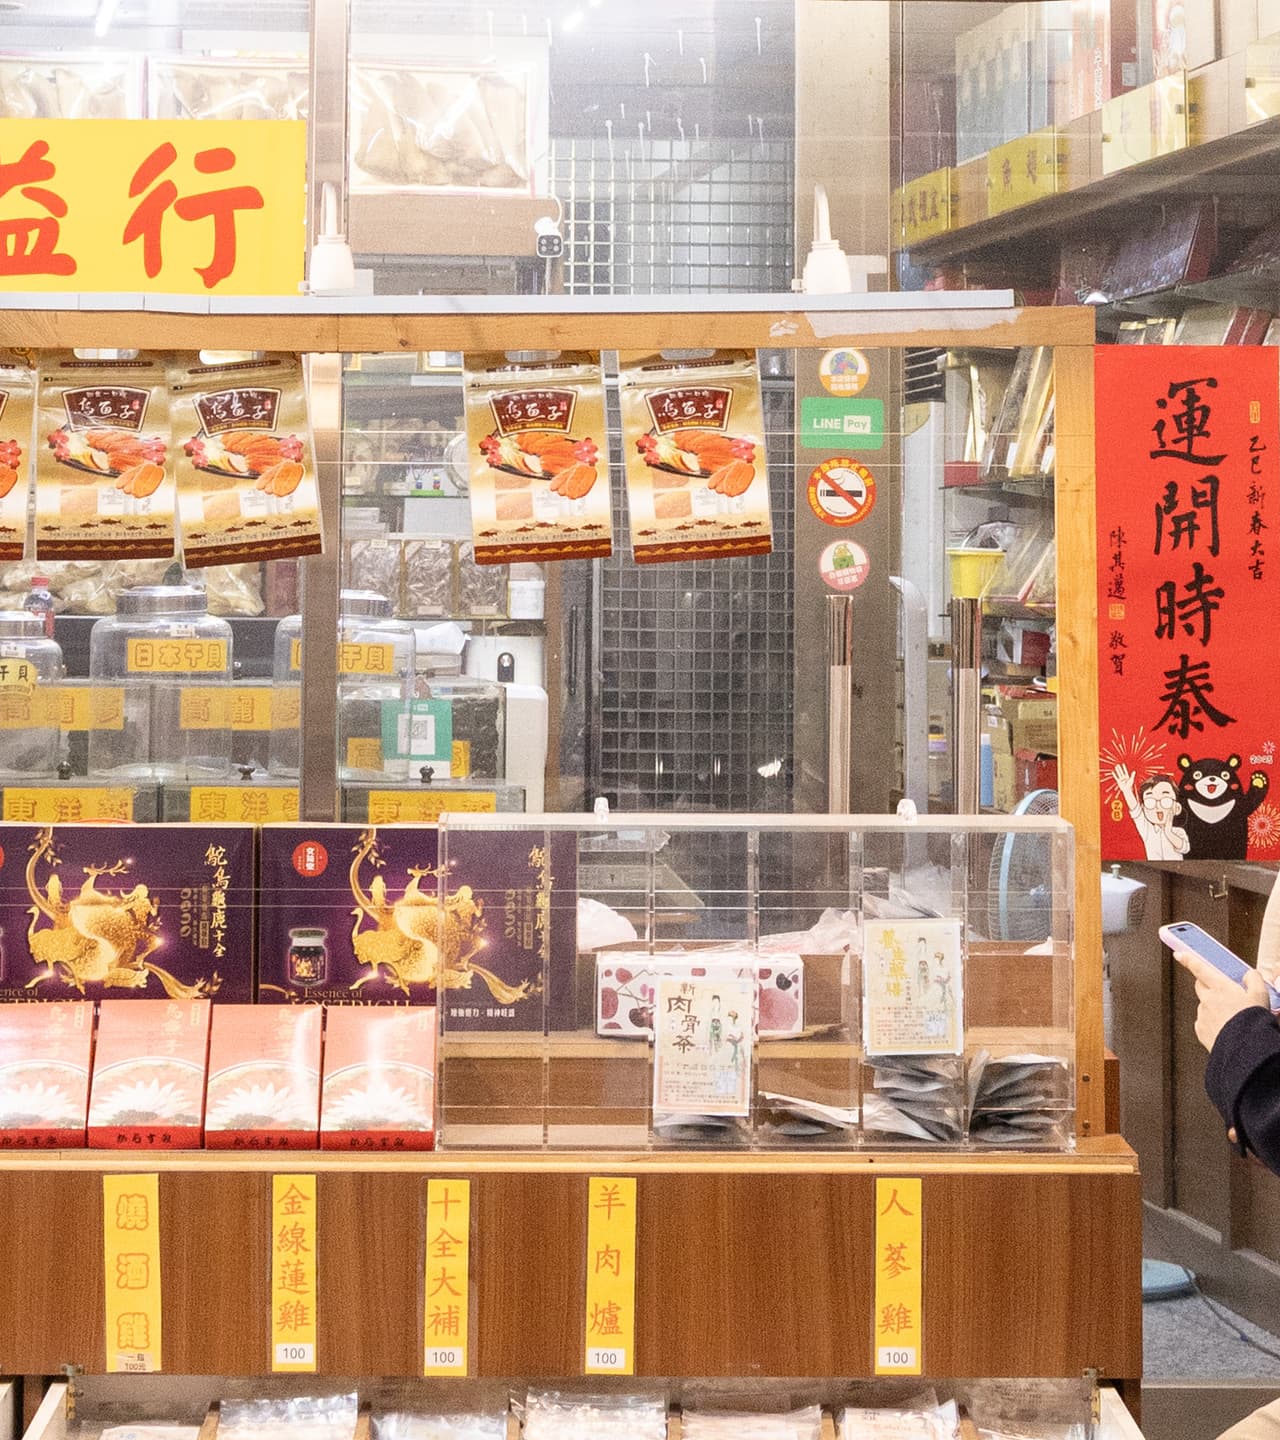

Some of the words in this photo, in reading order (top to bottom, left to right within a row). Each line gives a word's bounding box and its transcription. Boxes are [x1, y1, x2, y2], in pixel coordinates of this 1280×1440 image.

[813, 417, 841, 430] LINE
[847, 417, 868, 431] Pay
[1246, 435, 1269, 581] 乙巳新春大吉
[1107, 526, 1127, 601] 陳其邁
[1149, 376, 1238, 741] 運開時泰
[134, 642, 224, 669] 日本干貝
[302, 986, 349, 999] Essence
[116, 1193, 151, 1350] 燒酒雞
[276, 1183, 312, 1333] 金線蓮雞
[429, 1189, 462, 1337] 十全大補
[588, 1186, 627, 1336] 羊肉爐
[880, 1187, 915, 1335] 人蔘雞
[281, 1345, 306, 1361] 100
[430, 1349, 456, 1365] 100
[593, 1350, 618, 1366] 100
[883, 1350, 909, 1365] 100
